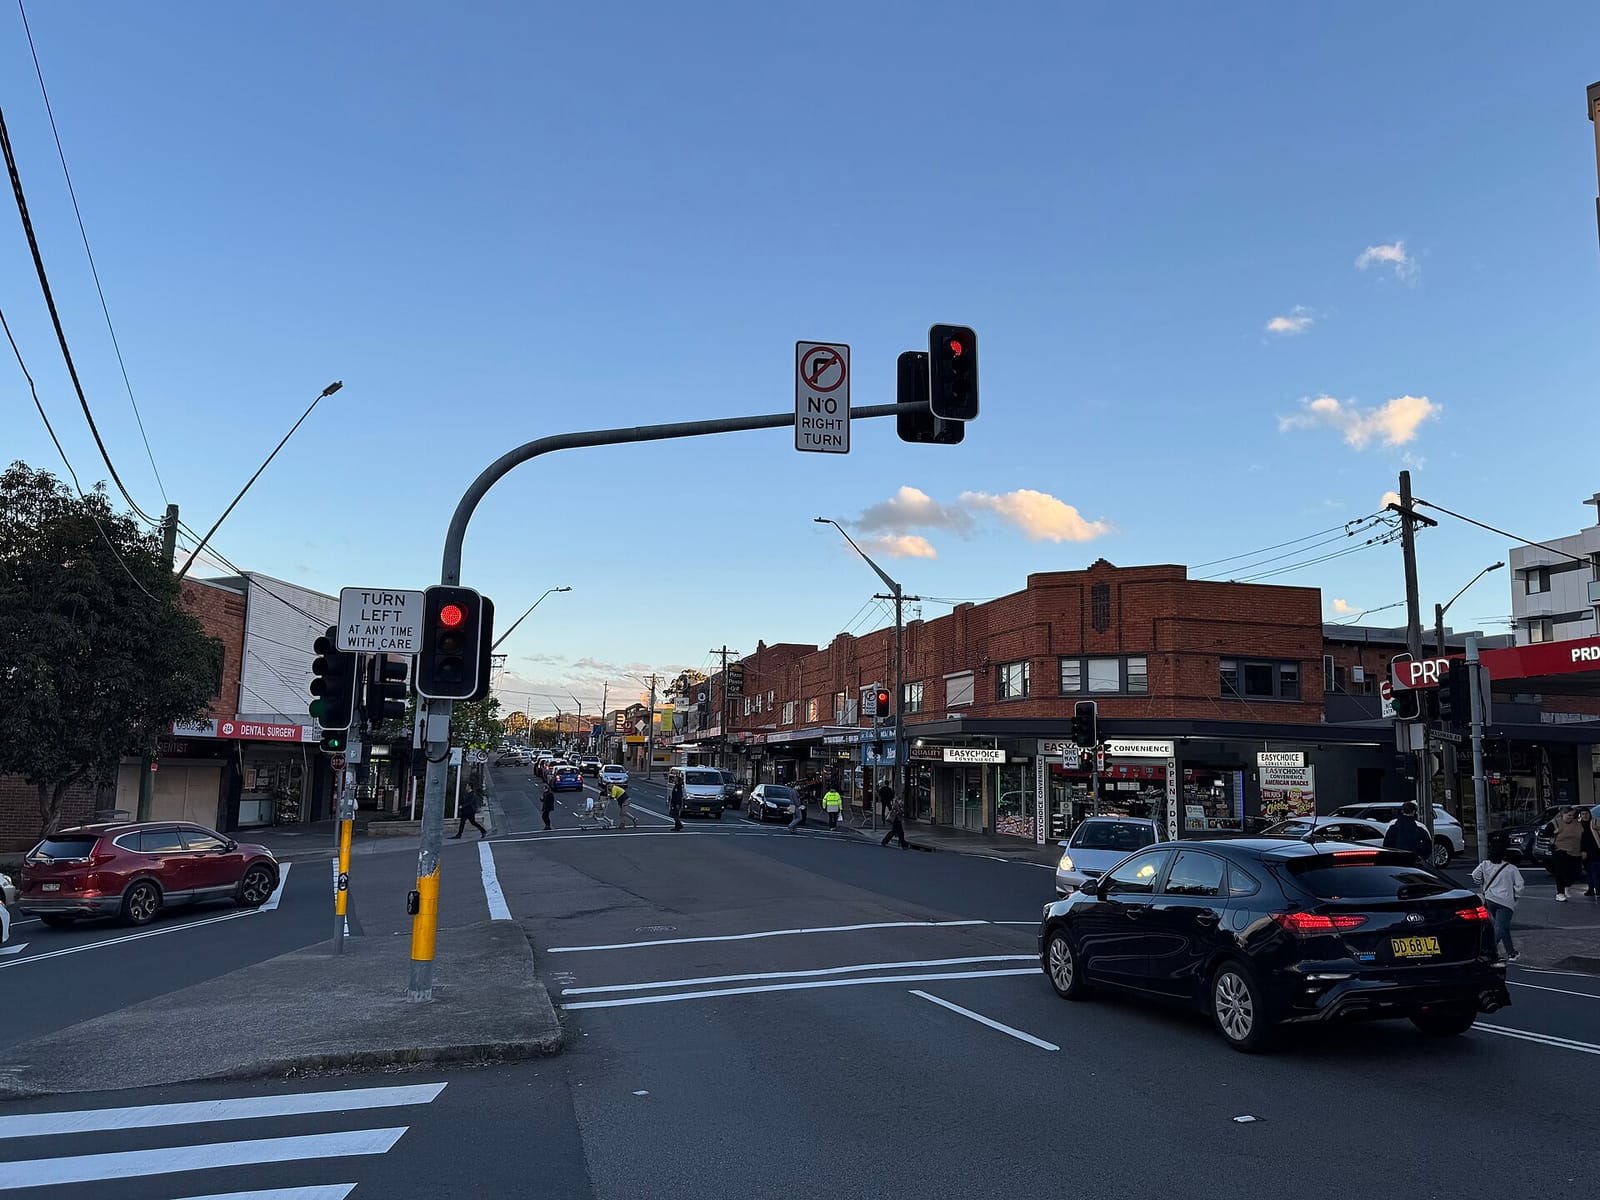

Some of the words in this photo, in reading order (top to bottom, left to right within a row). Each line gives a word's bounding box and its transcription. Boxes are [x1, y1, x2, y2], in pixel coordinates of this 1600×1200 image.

[808, 397, 838, 415] NO
[802, 417, 843, 430] RIGHT
[804, 433, 842, 446] TURN
[361, 592, 406, 606] TURN
[361, 609, 403, 622] LEFT
[348, 624, 361, 635] AT
[365, 625, 386, 635] ANY
[390, 626, 413, 637] TIME
[348, 637, 375, 648] WITH
[381, 638, 412, 649] CARE
[1571, 646, 1600, 662] PRD
[240, 724, 266, 736] DENTAL
[267, 726, 296, 738] SURGERY
[949, 750, 1000, 758] EASYCHOICE
[1114, 745, 1170, 753] CONVENIENCE
[1064, 755, 1078, 763] WAY
[1168, 762, 1176, 795] OPEN
[1392, 941, 1407, 953] DD
[1409, 939, 1423, 951] 68
